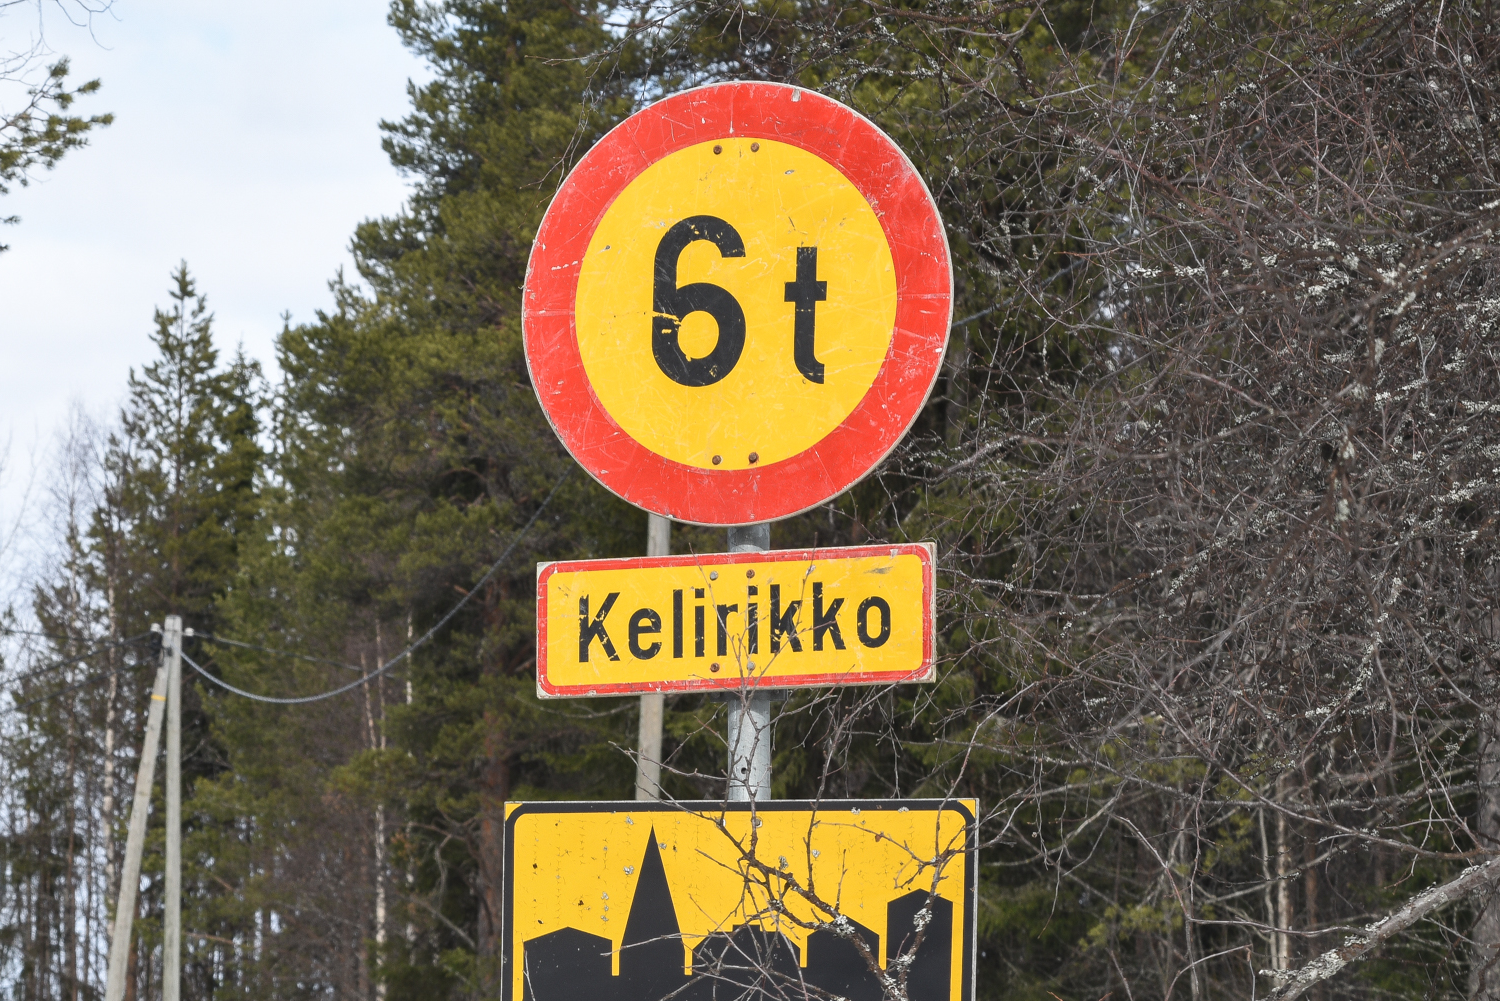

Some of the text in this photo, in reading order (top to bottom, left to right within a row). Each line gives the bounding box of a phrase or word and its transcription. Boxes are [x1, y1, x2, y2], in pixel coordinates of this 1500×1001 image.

[651, 214, 827, 388] 6 t
[578, 581, 892, 663] Kelirikko
